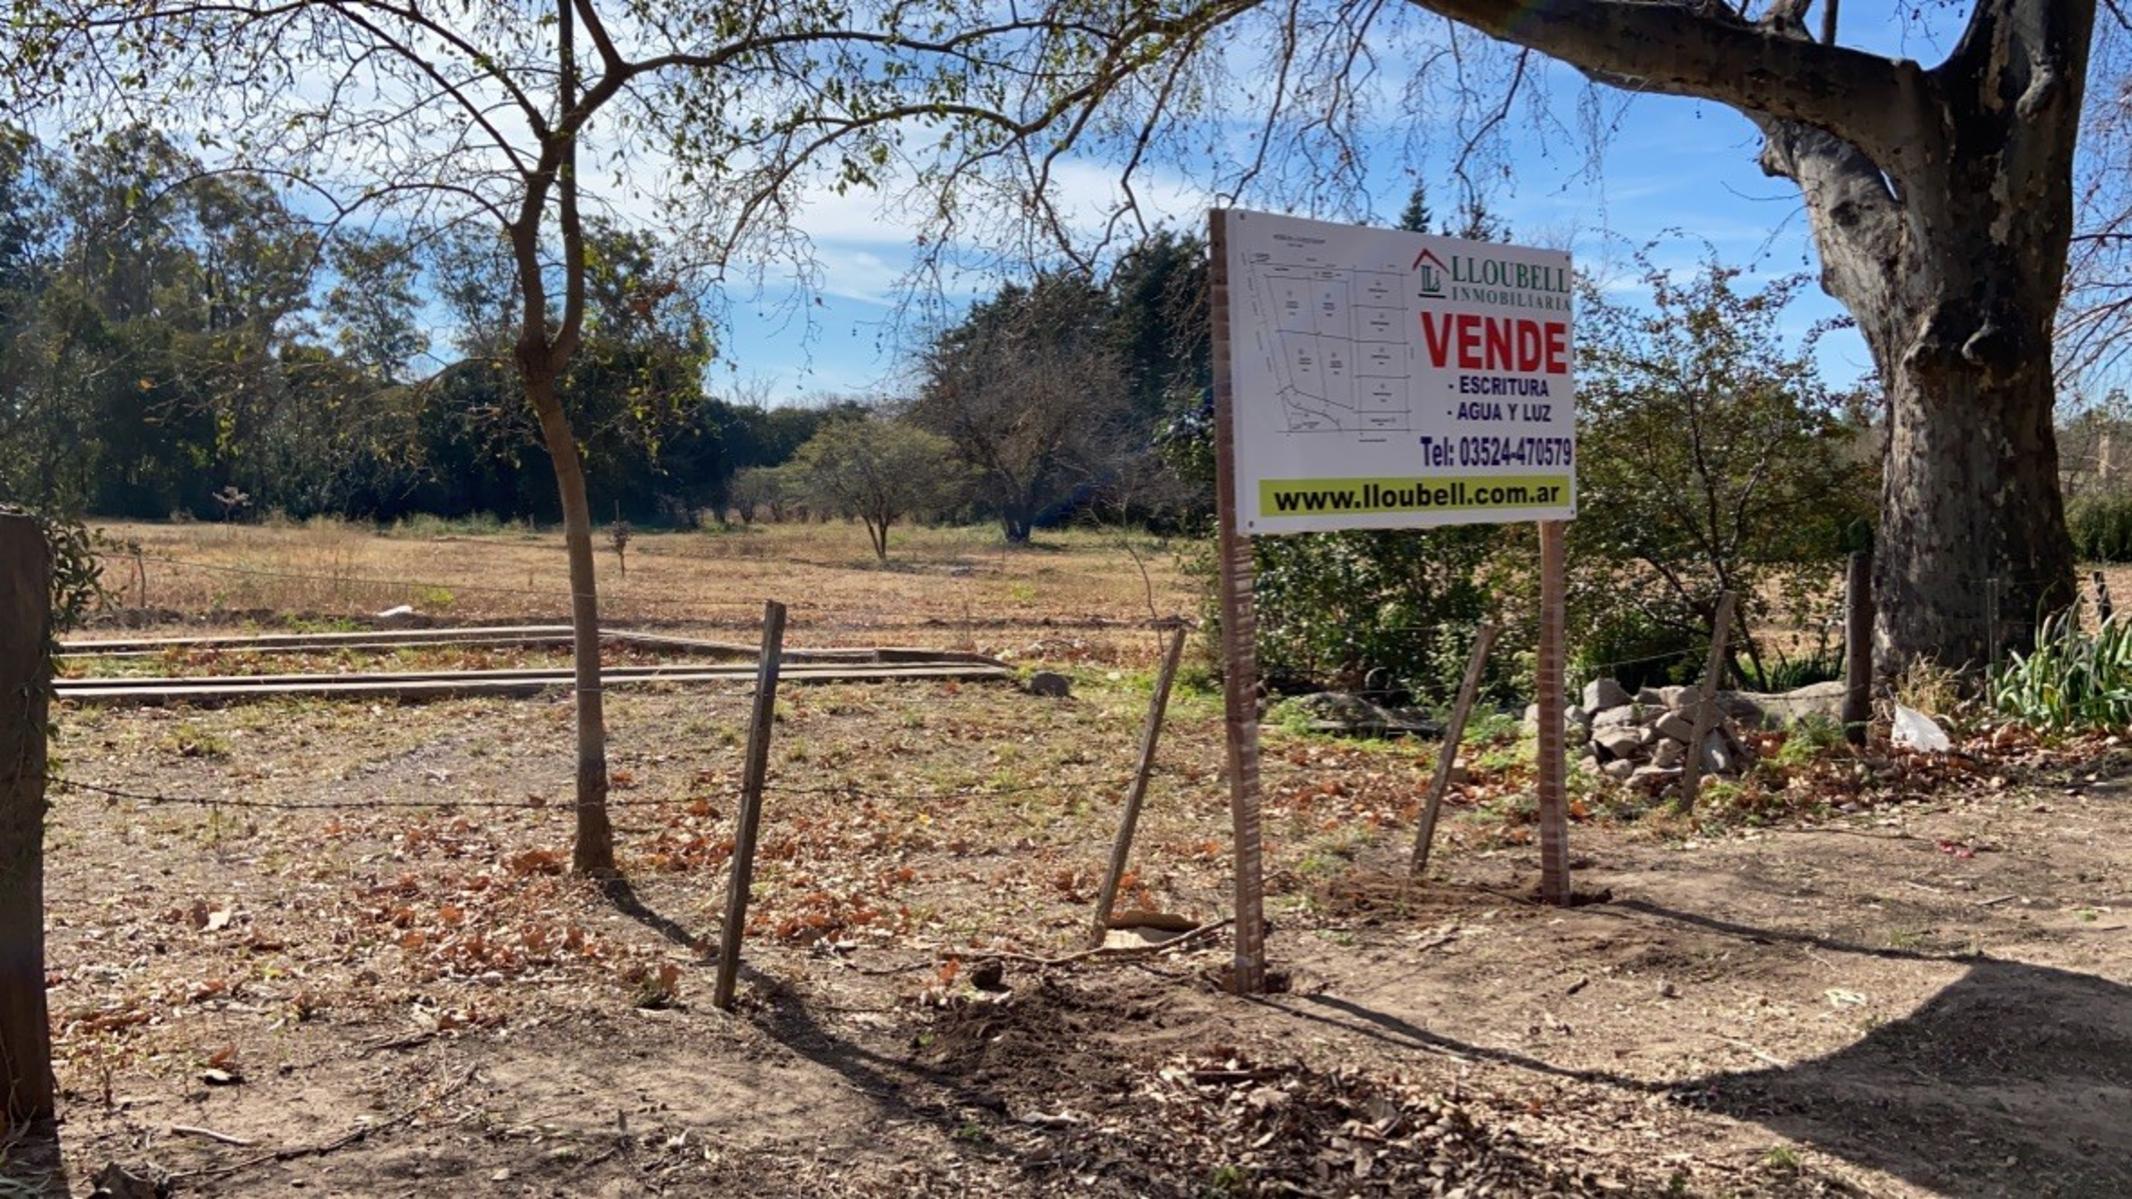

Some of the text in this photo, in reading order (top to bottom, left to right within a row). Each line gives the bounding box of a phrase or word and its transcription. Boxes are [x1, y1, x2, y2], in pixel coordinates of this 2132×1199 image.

[1452, 255, 1571, 293] LLOUBELL
[1453, 287, 1572, 312] INMOBILIARIA
[1421, 311, 1566, 374] VENDE
[1460, 376, 1549, 397] ESCRITURA
[1457, 402, 1552, 422] AGUA Y LUZ
[1421, 436, 1572, 467] Tel: 03524-470579
[1274, 482, 1560, 511] www.lloubell.com.ar
